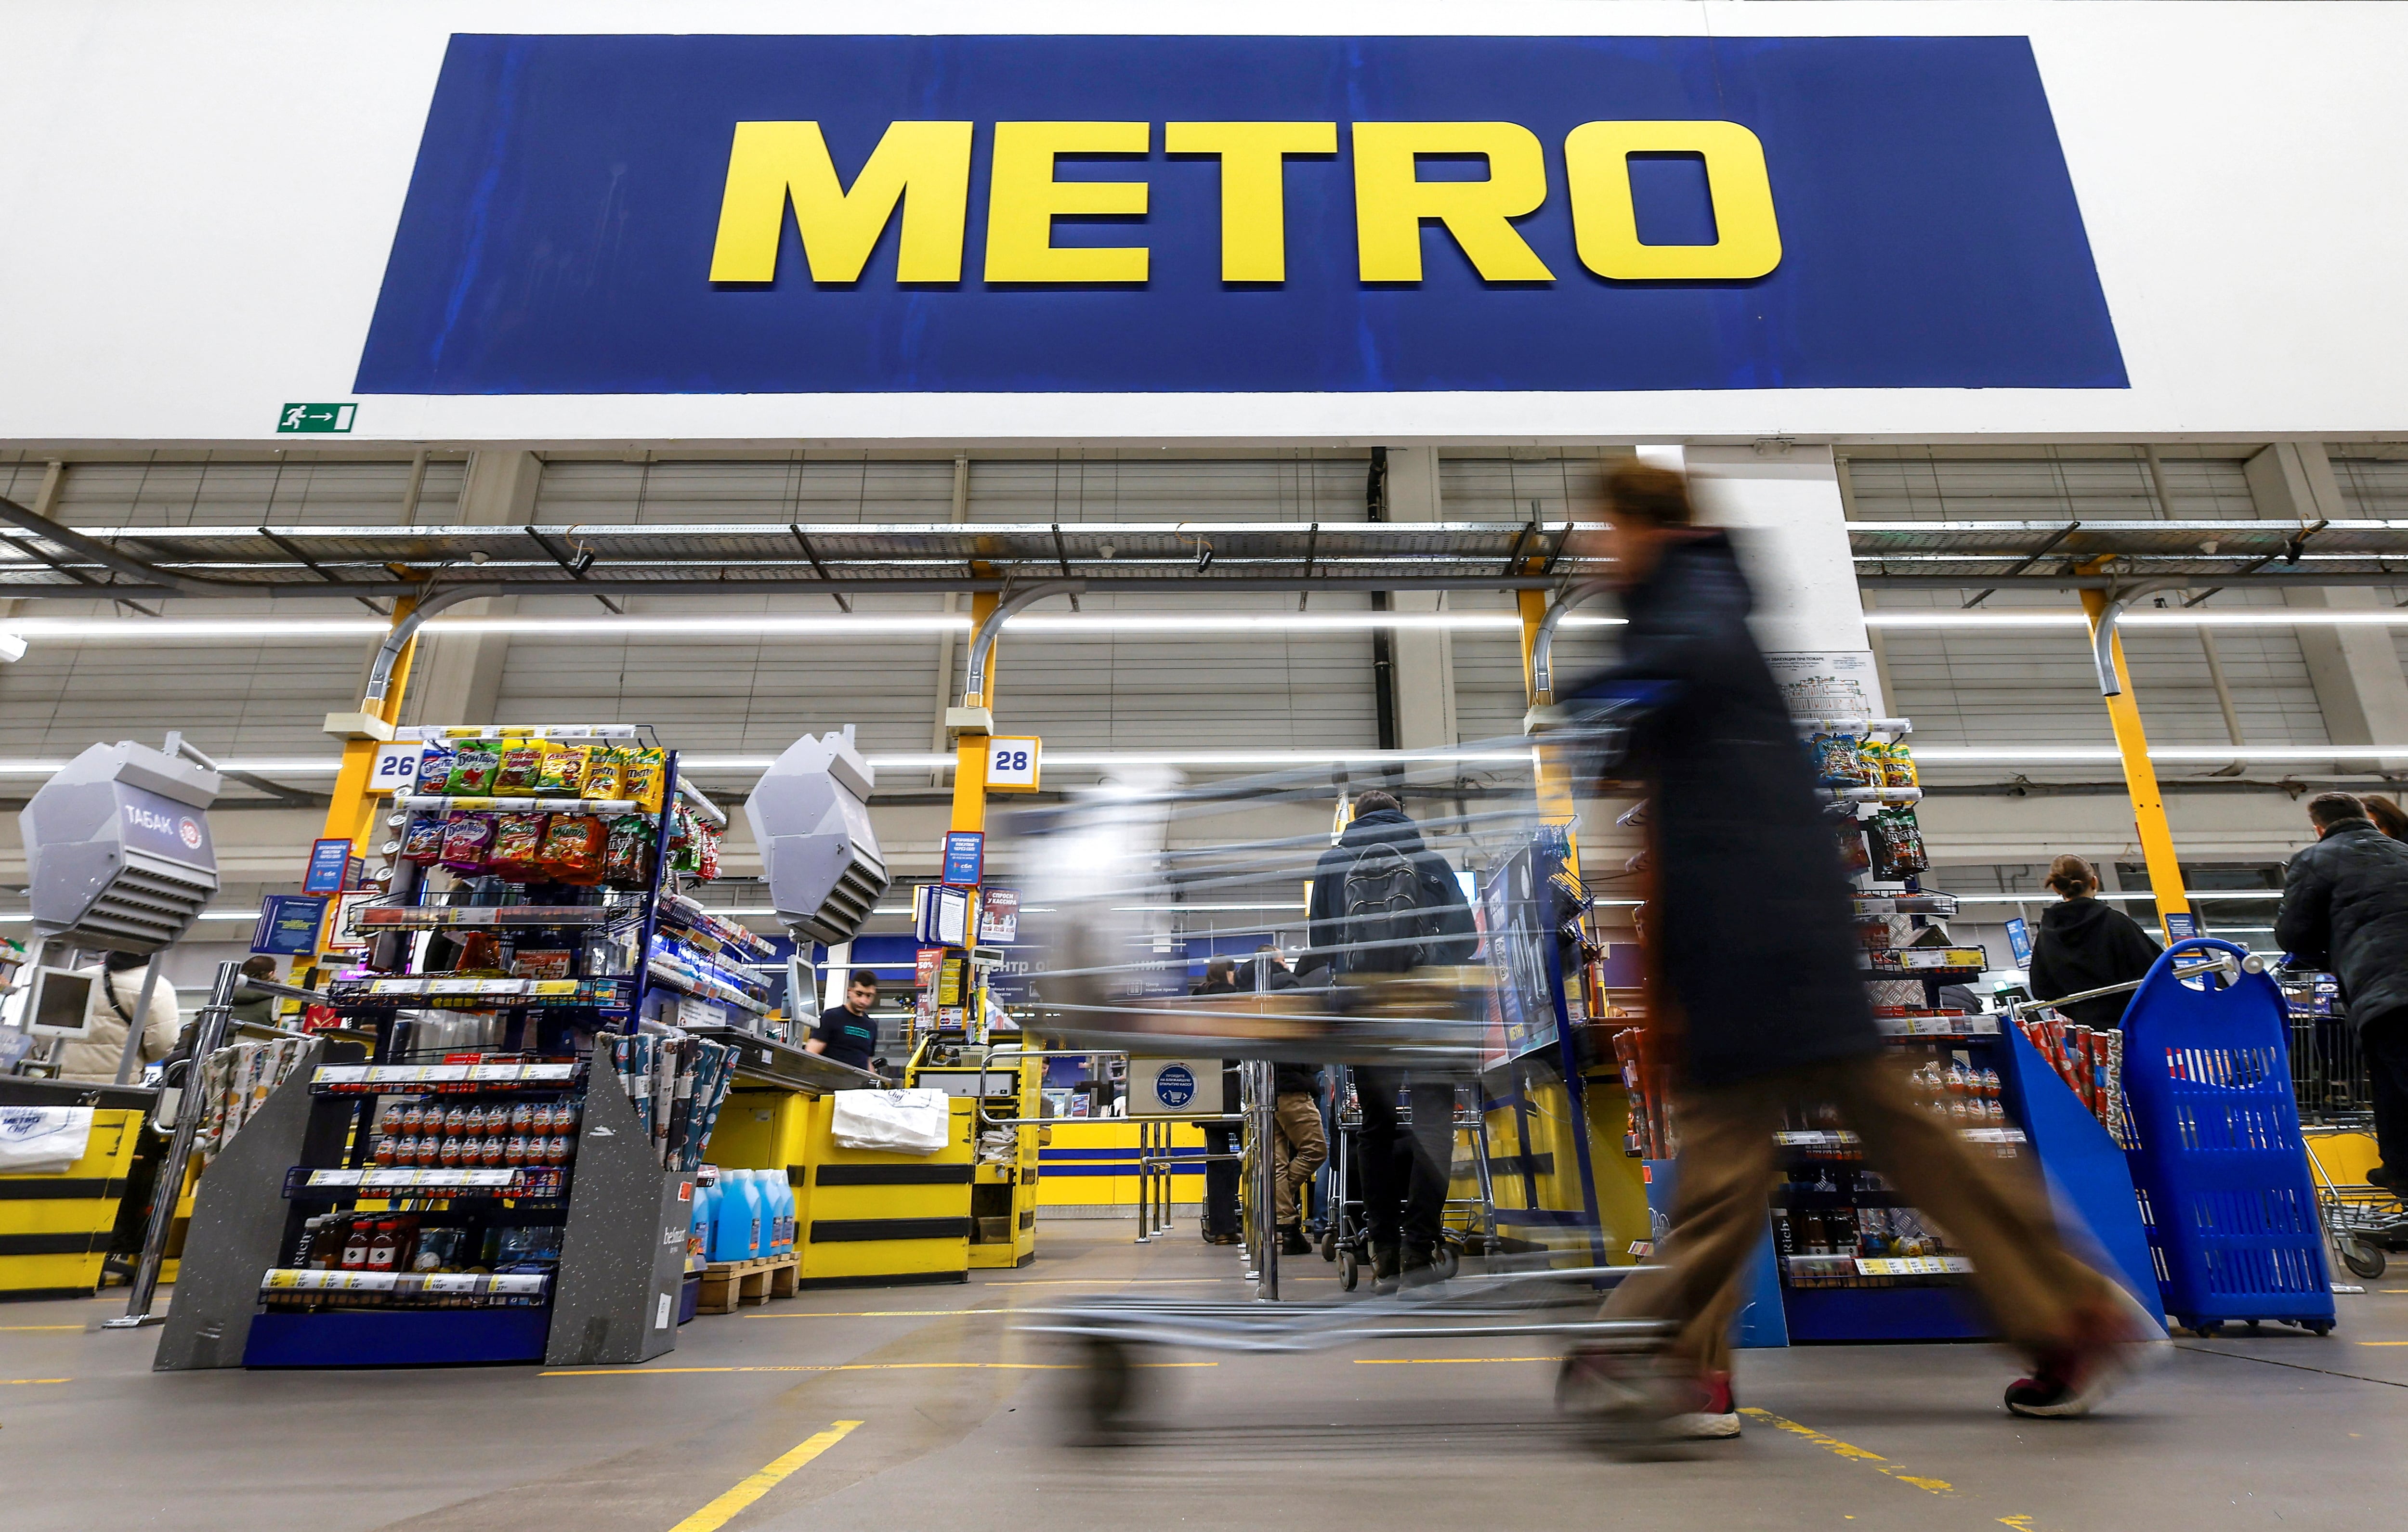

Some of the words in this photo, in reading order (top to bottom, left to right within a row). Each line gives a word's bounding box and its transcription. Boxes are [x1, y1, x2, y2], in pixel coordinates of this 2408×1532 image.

[710, 122, 1782, 283] METRO
[380, 756, 415, 776] 26
[996, 751, 1027, 770] 28
[125, 804, 174, 836] ТАБАК
[888, 1090, 905, 1102] Chef
[293, 1233, 314, 1266] Rich
[1783, 1220, 1793, 1252] Rich
